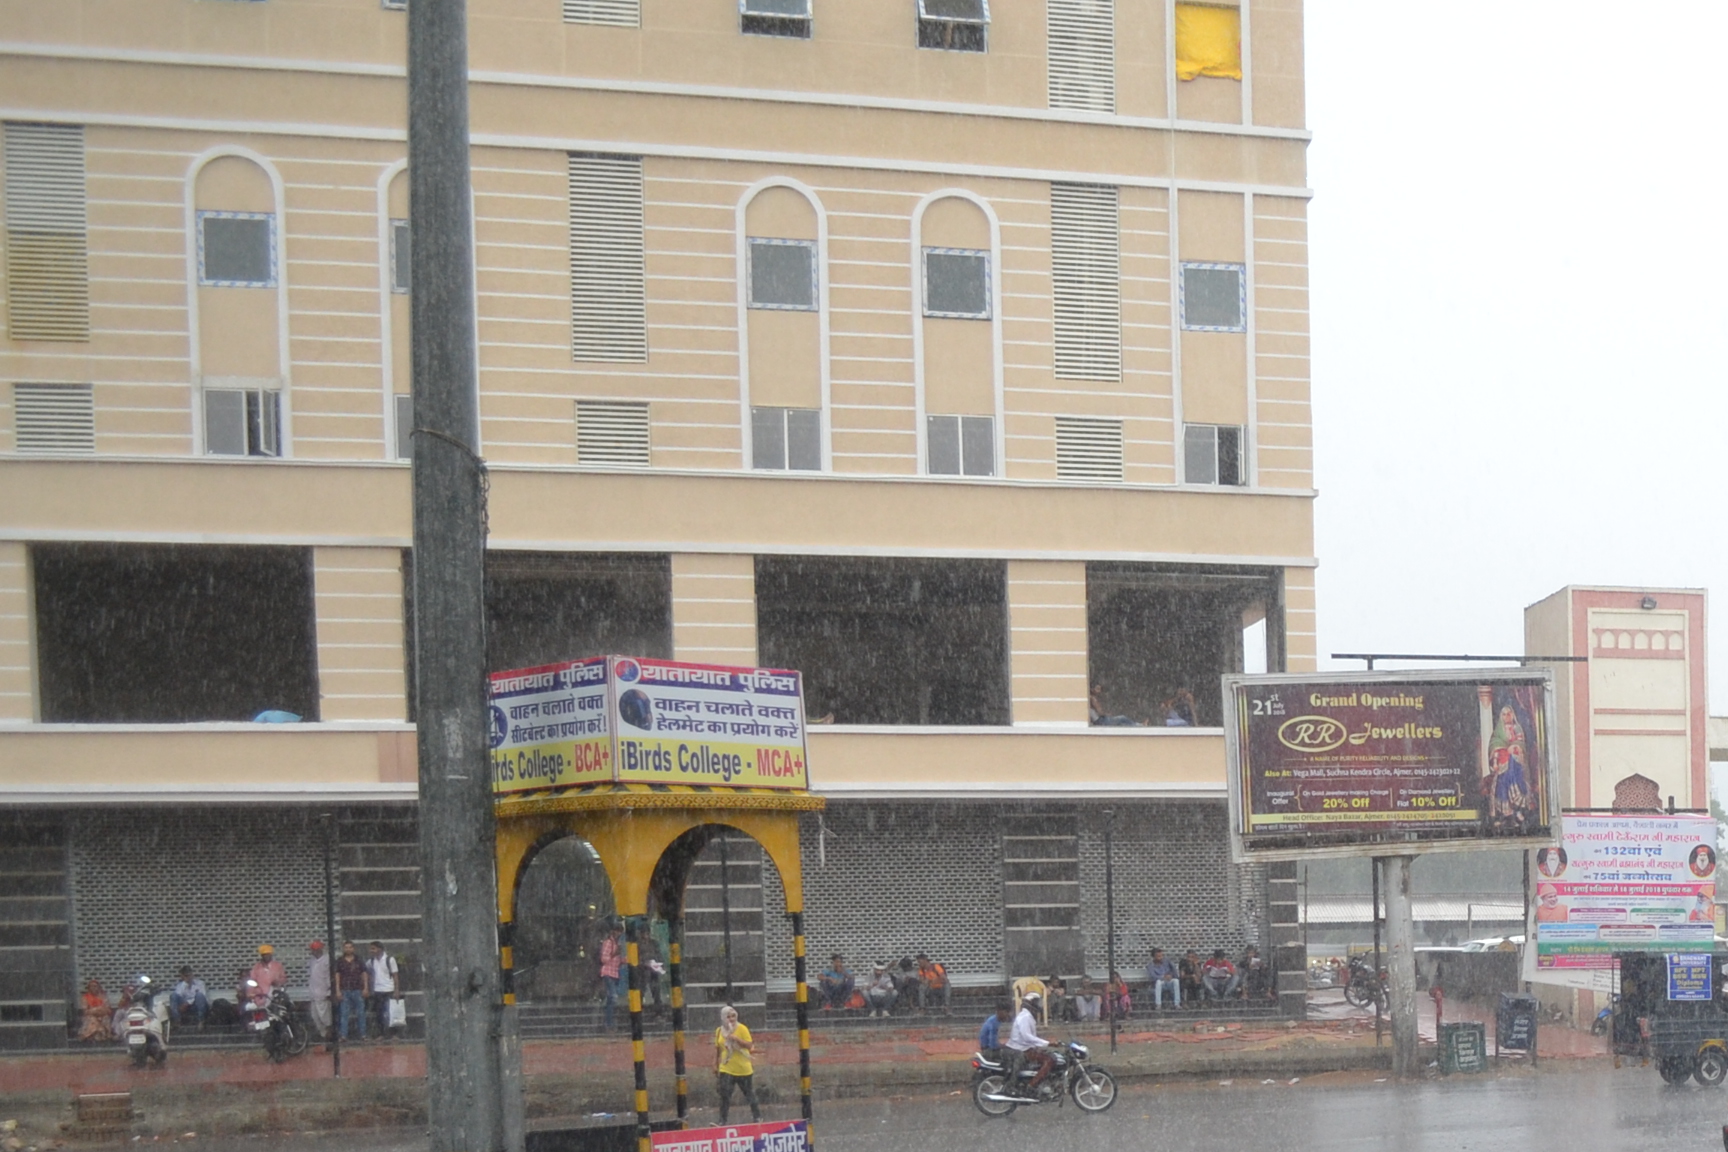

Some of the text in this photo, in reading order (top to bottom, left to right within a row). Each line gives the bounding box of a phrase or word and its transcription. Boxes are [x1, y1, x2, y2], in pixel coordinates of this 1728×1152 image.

[491, 662, 604, 694] यातायात पुलिस
[641, 665, 795, 692] यातायात पुलिस
[510, 694, 604, 720] वाहन चलाते वक्त
[654, 698, 796, 720] वाहन चलाते वक्त
[1253, 700, 1272, 715] 21
[1310, 692, 1424, 709] Grand Opening
[547, 724, 560, 738] का
[561, 717, 585, 737] प्रयोग
[657, 715, 799, 739] हेलमेट का प्रयोग करें
[1349, 722, 1443, 745] Jewellers
[518, 750, 563, 783] College
[575, 742, 609, 773] BCA+
[621, 741, 803, 782] iBirds College MCA+
[1293, 770, 1309, 778] Vega
[1350, 768, 1372, 776] Kendra
[1373, 768, 1392, 776] Circle,
[1323, 798, 1370, 808] 20% Off
[1411, 797, 1435, 807] 10%
[1439, 797, 1457, 806] Off
[1563, 832, 1585, 843] त्गुरु
[1604, 844, 1641, 855] 132वां
[1593, 870, 1619, 881] 75वां
